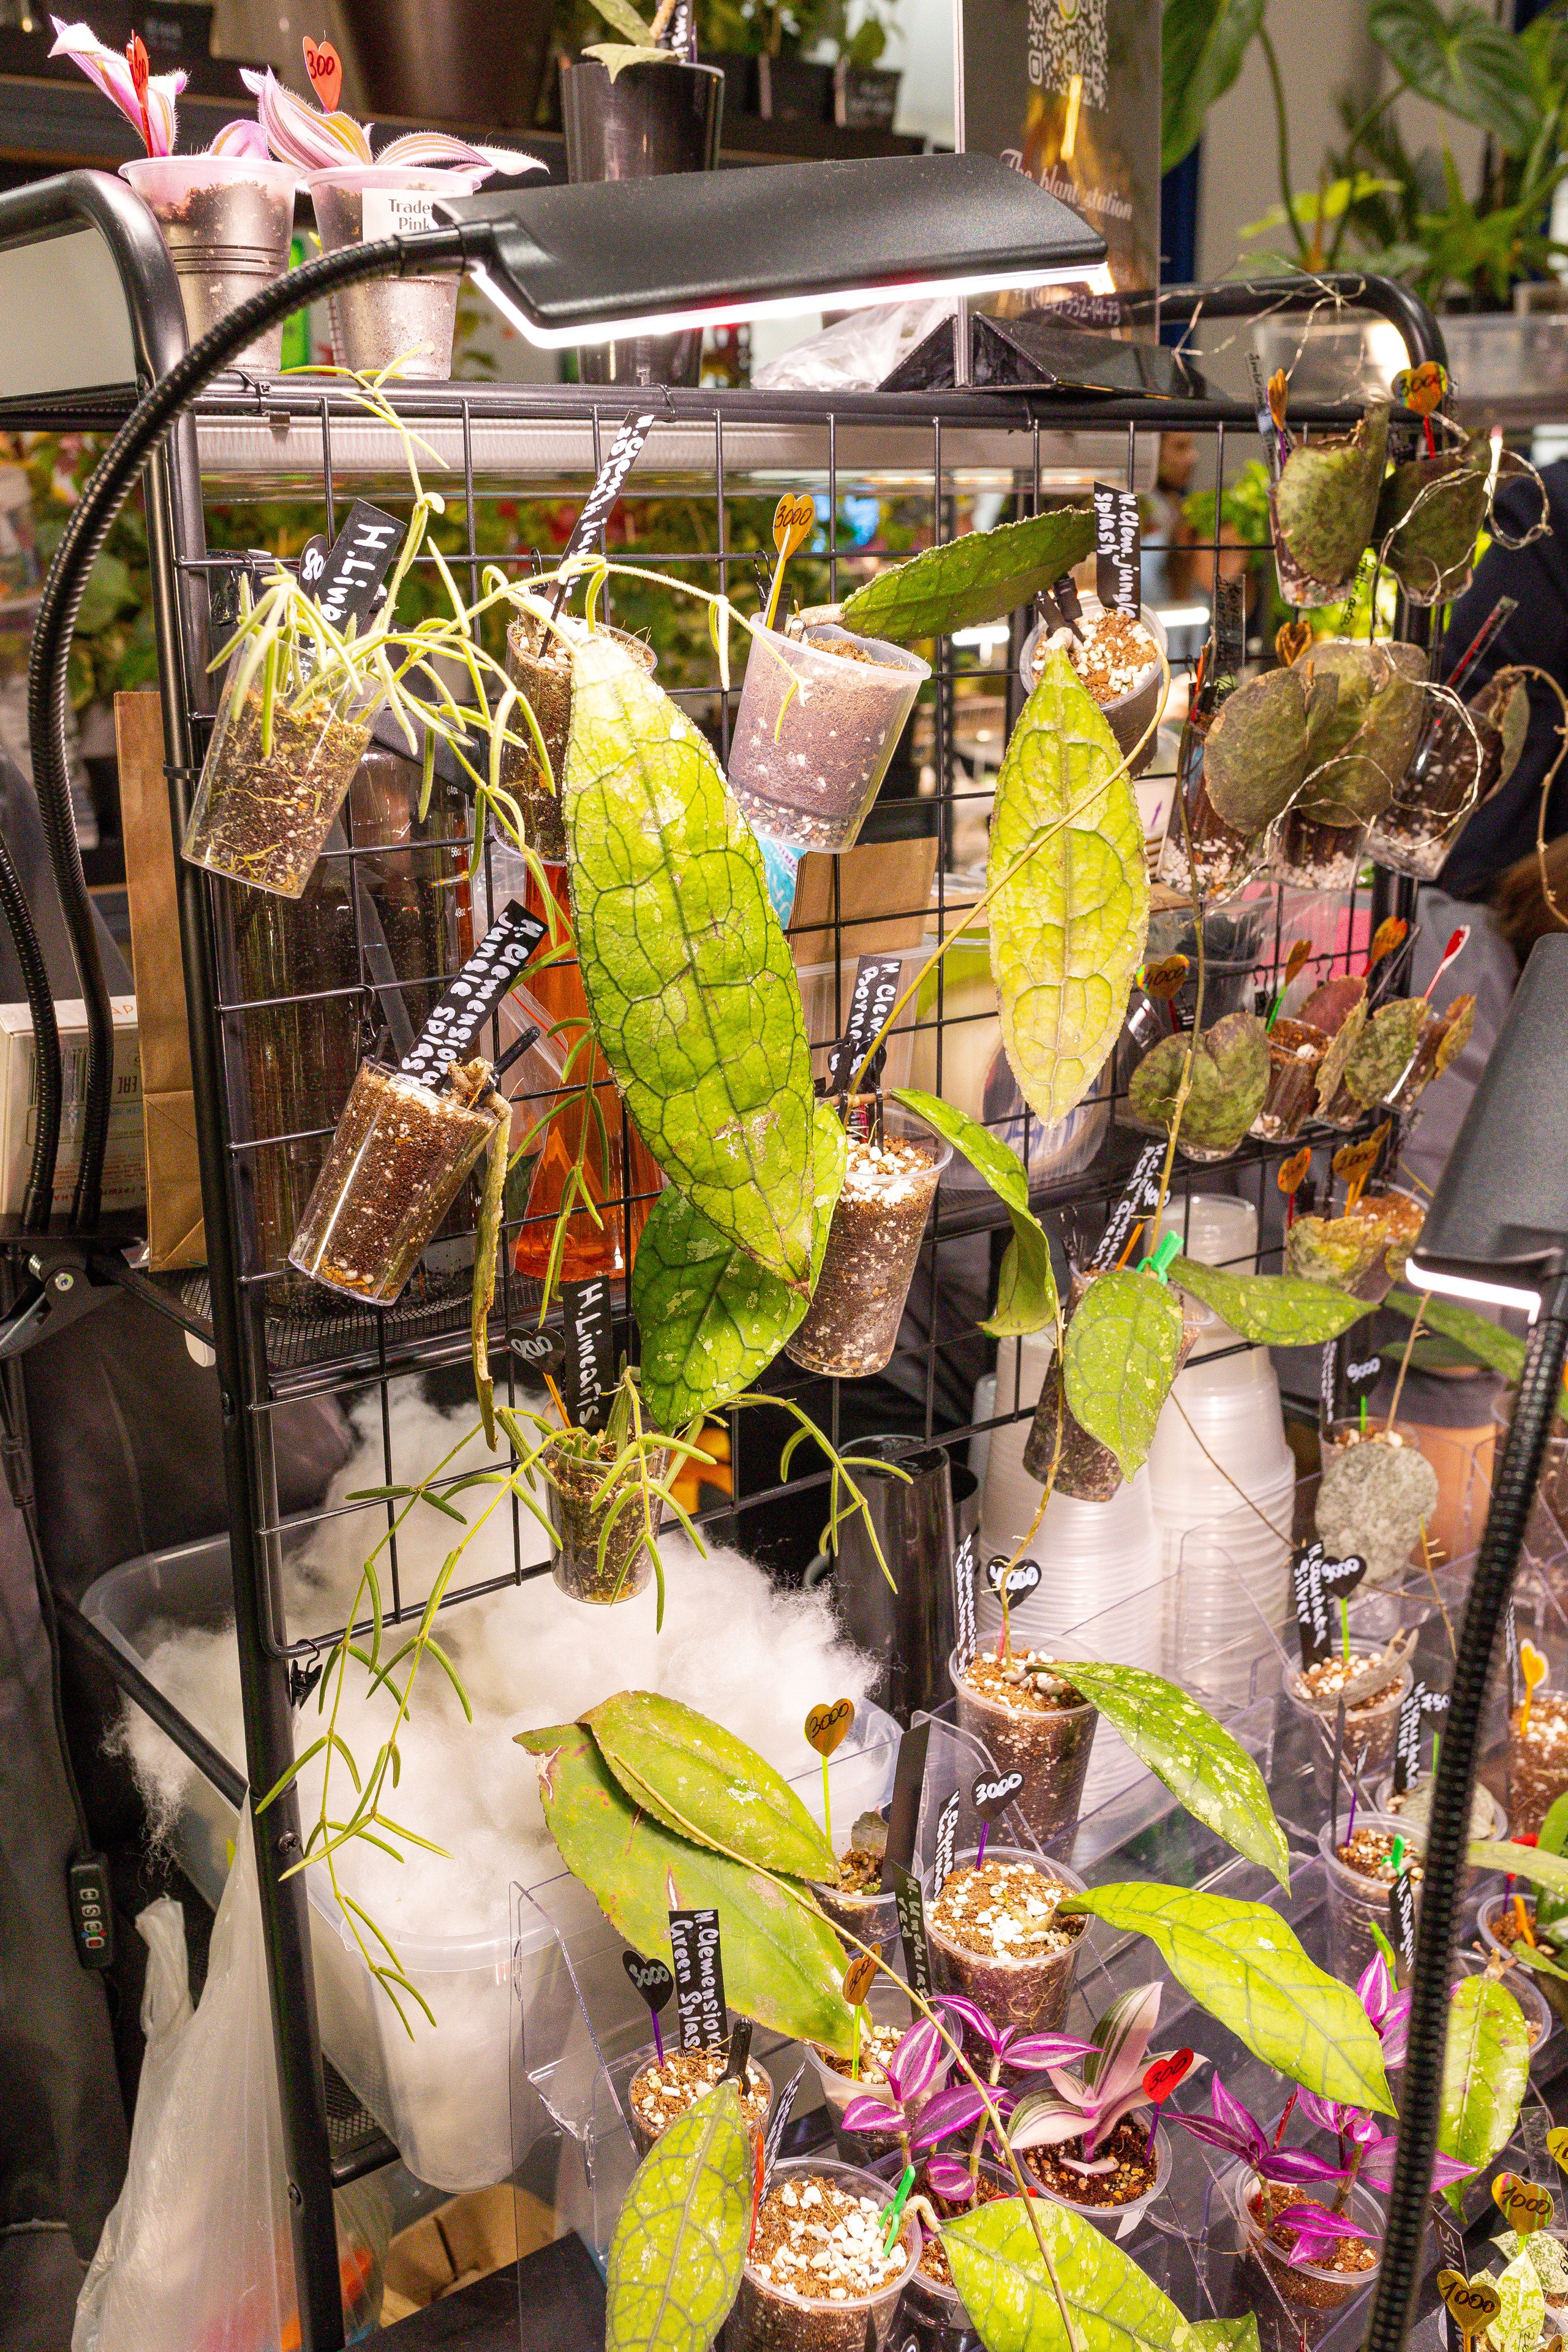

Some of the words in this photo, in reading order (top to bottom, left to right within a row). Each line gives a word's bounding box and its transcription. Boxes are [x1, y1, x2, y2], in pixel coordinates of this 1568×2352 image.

[307, 50, 335, 80] 300
[774, 505, 813, 529] 3000
[454, 907, 466, 918] 49oz
[1321, 1558, 1360, 1584] 9000
[809, 1703, 849, 1738] 3000
[976, 1773, 1022, 1806] 3000
[1149, 2057, 1188, 2092] 300
[1501, 2186, 1551, 2215] 1000
[1442, 2280, 1495, 2314] 1000
